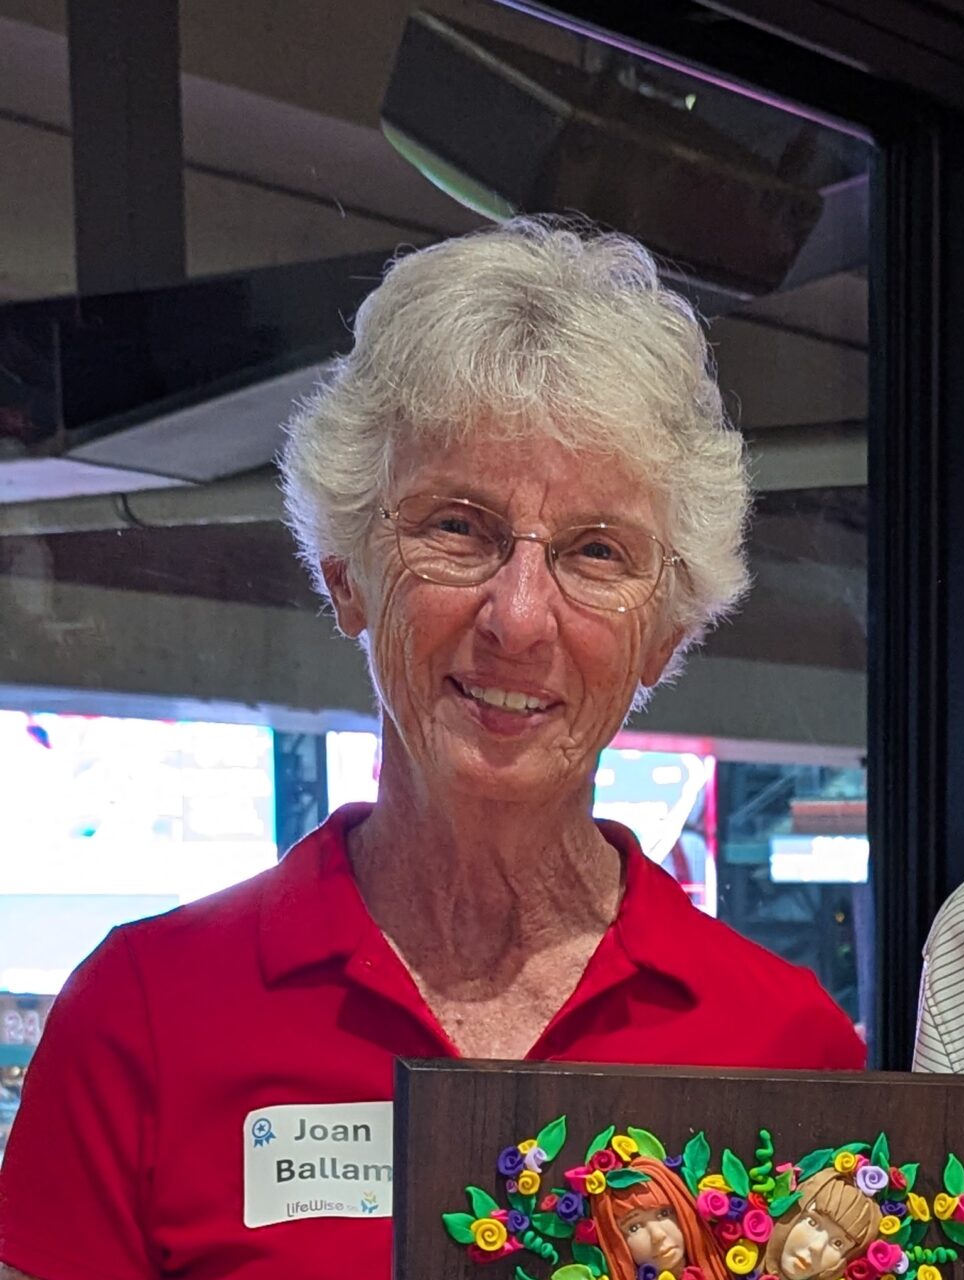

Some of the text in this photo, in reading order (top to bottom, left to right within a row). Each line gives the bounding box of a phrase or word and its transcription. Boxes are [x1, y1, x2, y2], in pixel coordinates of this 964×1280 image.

[294, 1118, 371, 1142] Joan
[276, 1157, 393, 1183] Ballam
[287, 1199, 345, 1217] LifeWise
